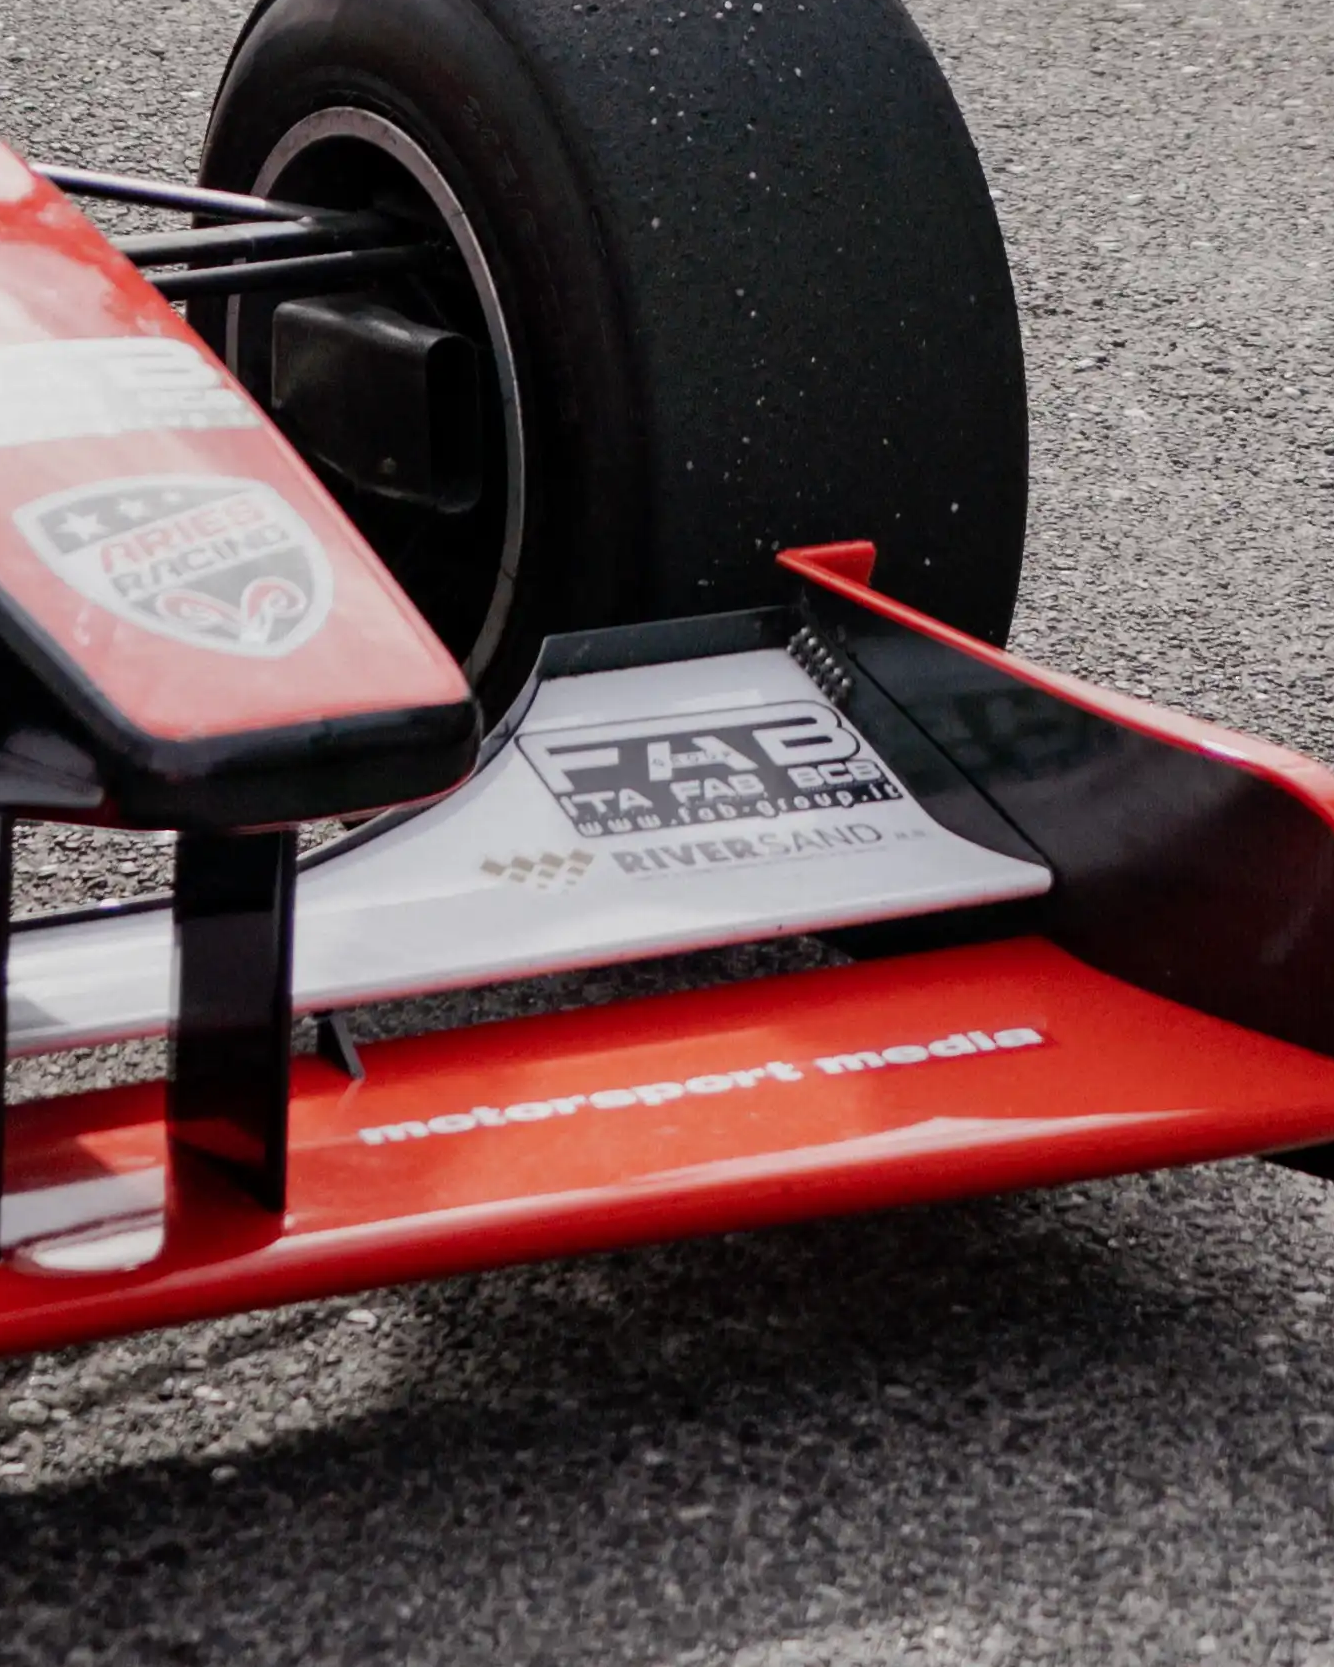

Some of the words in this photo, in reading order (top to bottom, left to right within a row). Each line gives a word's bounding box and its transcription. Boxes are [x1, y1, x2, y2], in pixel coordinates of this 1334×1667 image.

[100, 495, 267, 574] ARIES
[110, 521, 292, 598] RACING
[514, 700, 862, 794] FAB
[669, 773, 767, 804] FAB
[611, 821, 883, 876] RIVERSAND
[359, 1060, 806, 1145] motorsport
[814, 1026, 1045, 1077] media
